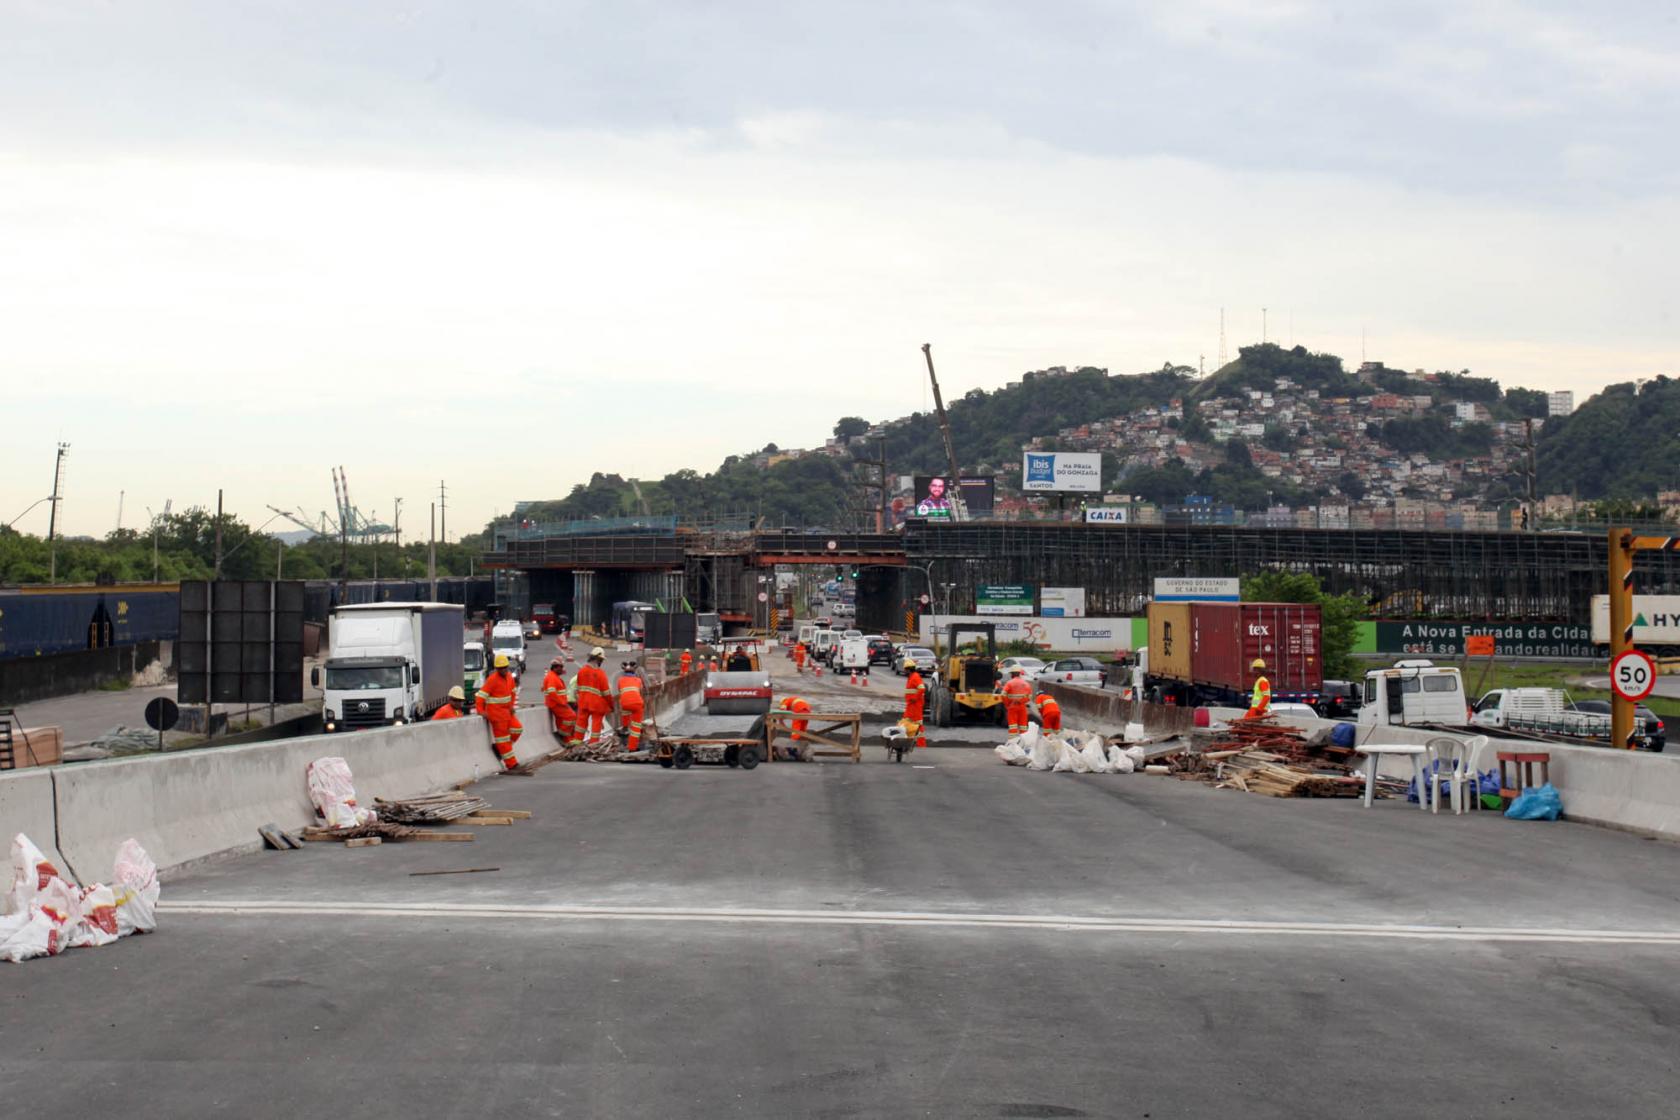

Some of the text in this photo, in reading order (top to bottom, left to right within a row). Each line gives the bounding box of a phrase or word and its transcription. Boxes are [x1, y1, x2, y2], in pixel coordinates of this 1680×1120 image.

[1033, 459, 1049, 469] ibis
[1091, 512, 1122, 520] CAIXA
[1249, 624, 1269, 636] tex
[1402, 625, 1593, 640] A Nova Entrada da Cida
[1438, 644, 1456, 654] se
[1620, 666, 1646, 684] 50
